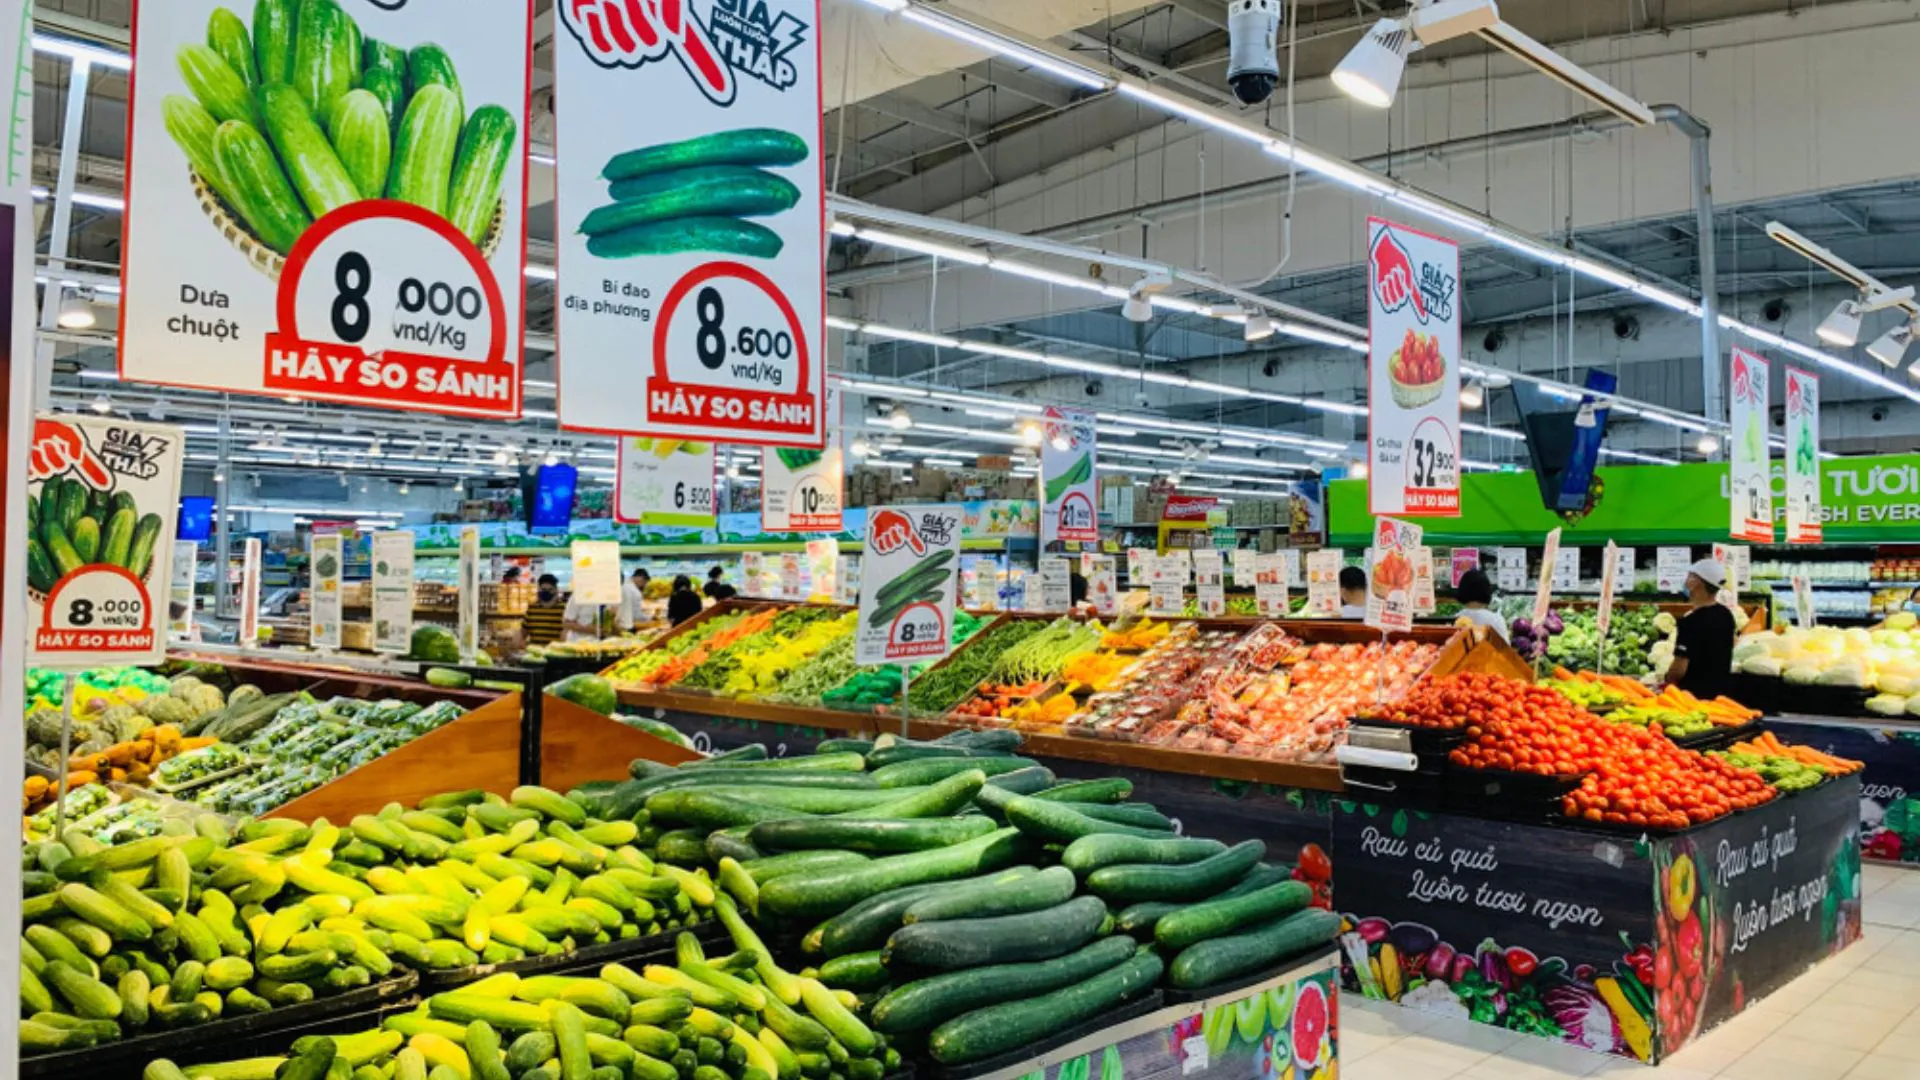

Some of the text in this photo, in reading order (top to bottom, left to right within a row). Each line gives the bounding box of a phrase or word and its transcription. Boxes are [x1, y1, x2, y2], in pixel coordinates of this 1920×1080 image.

[180, 283, 230, 309] Dưa
[593, 300, 651, 322] phương
[166, 313, 240, 343] chuột
[393, 320, 466, 351] vnd/Kg
[271, 347, 509, 401] HÃY SO SÁNH
[731, 362, 783, 386] vnd/Kg
[651, 388, 812, 426] HÃY SO SÁNH
[1826, 464, 1918, 497] TƯƠI
[39, 632, 151, 647] HÃY SO SÁNH
[1361, 826, 1498, 873] Rau củ quả
[1716, 839, 1748, 888] Rau
[1407, 869, 1603, 930] Luôn tươi ngon
[1731, 899, 1769, 954] Luôn
